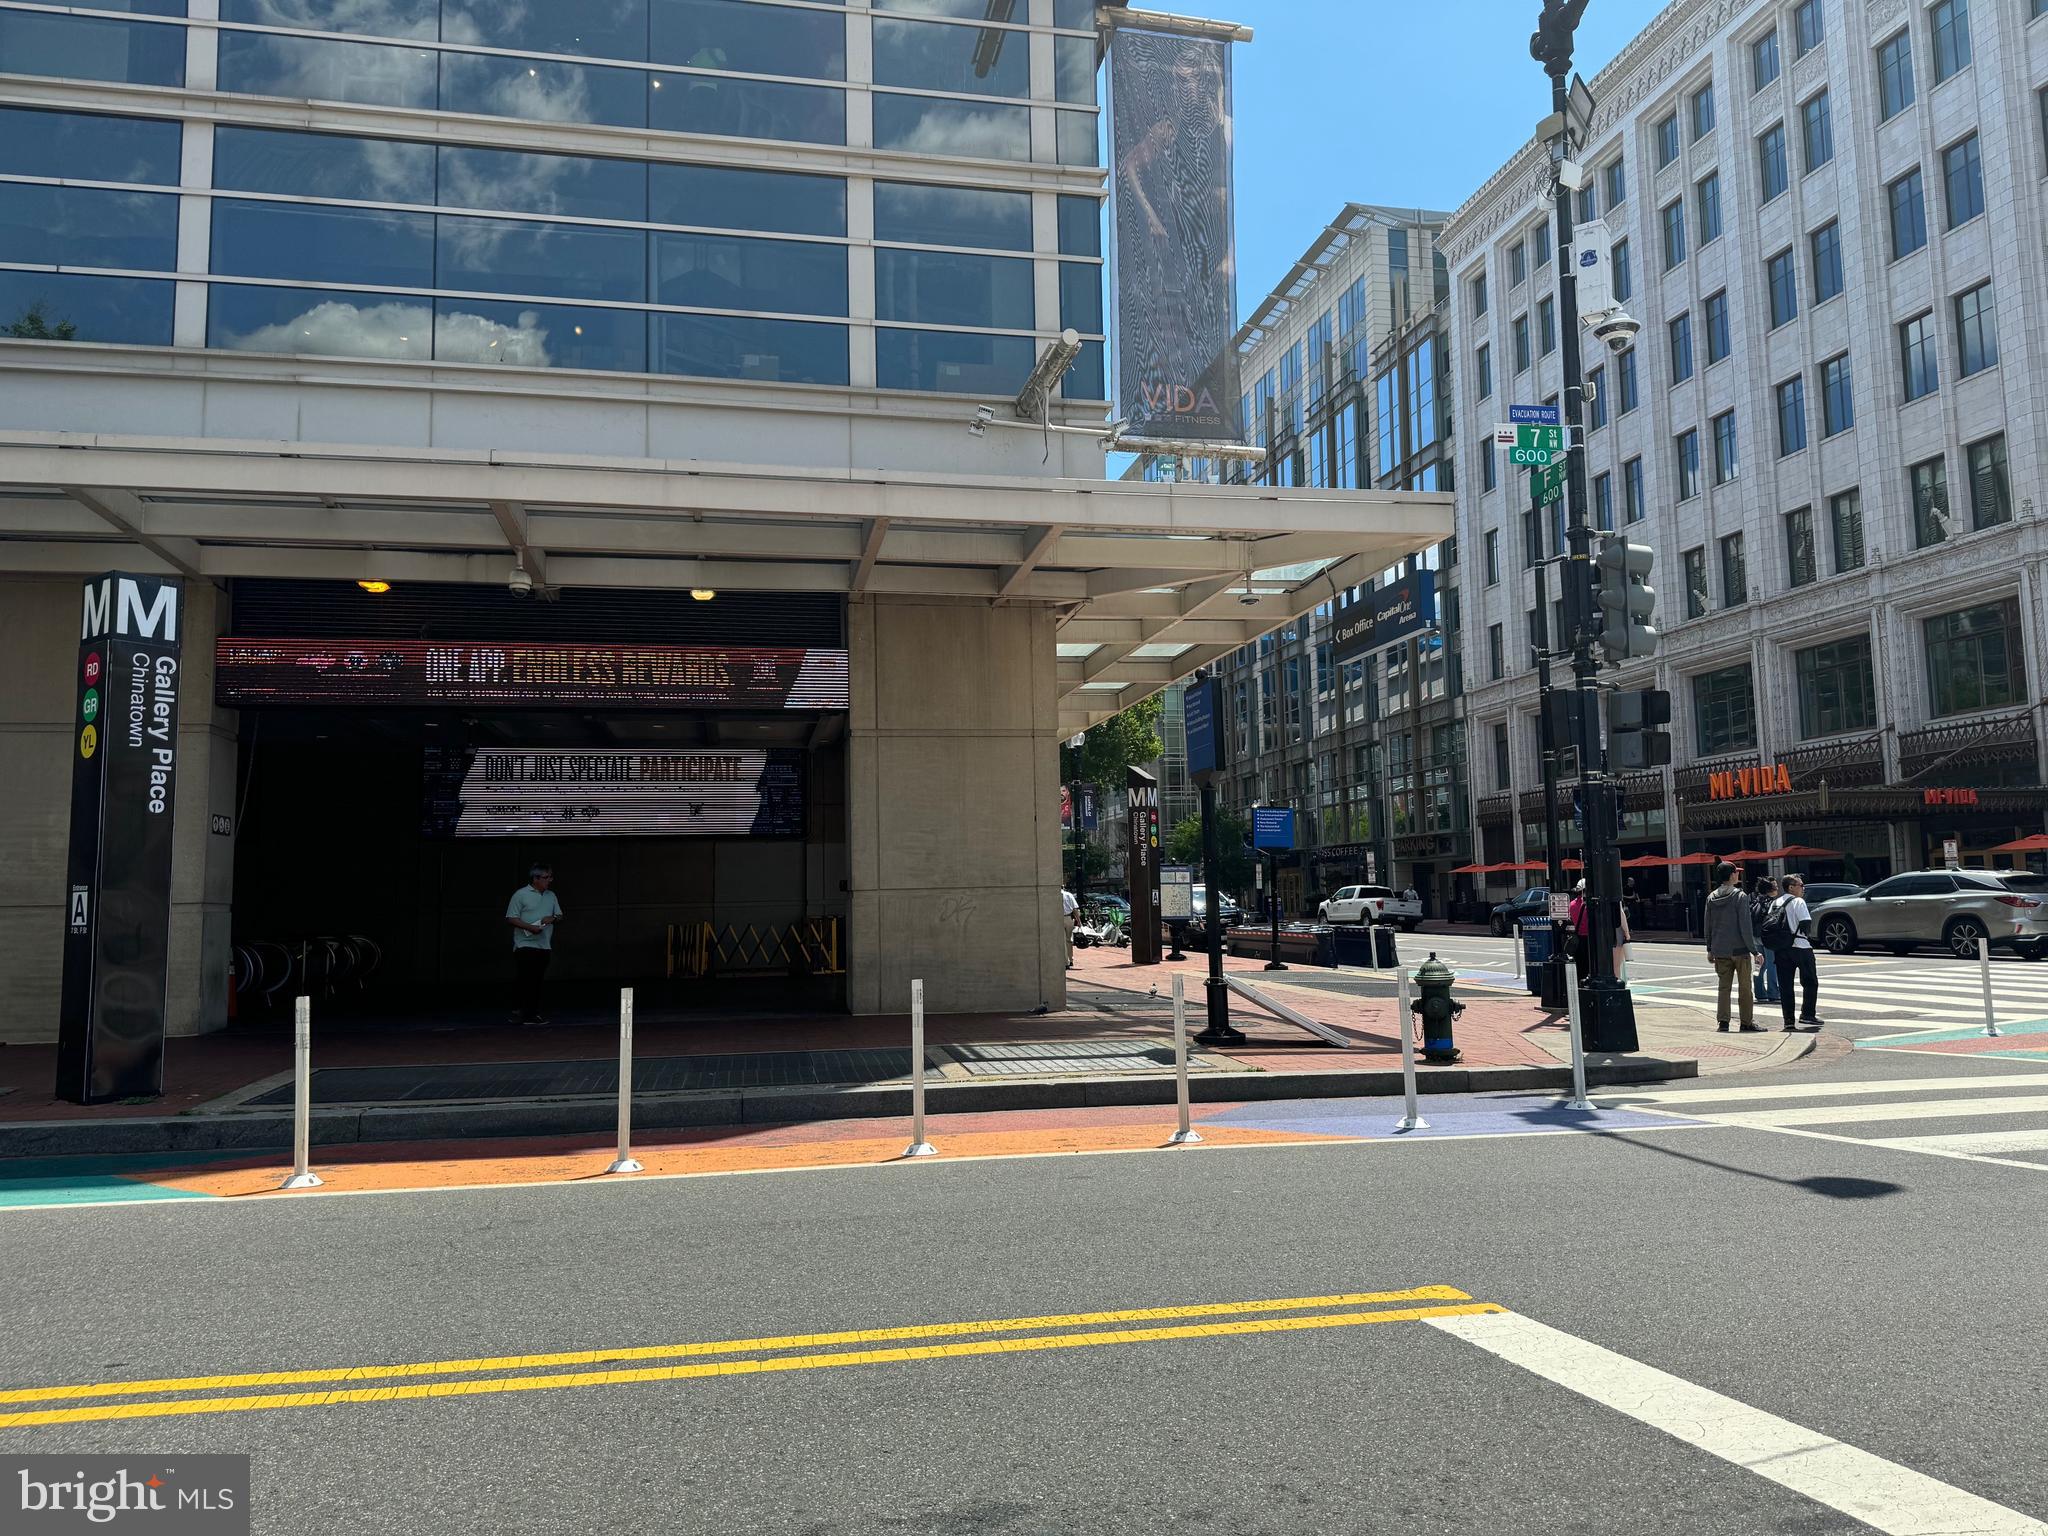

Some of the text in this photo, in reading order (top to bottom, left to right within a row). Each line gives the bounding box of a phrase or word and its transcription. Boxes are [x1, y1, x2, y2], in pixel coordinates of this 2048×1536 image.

[1141, 380, 1220, 414] VIDA
[1175, 415, 1221, 425] FITNESS
[1512, 409, 1556, 419] EVACUATION ROUTE
[1531, 429, 1557, 447] 7 St
[1549, 439, 1558, 448] NW
[1515, 449, 1547, 463] 600
[1543, 469, 1552, 489] F
[1543, 485, 1559, 503] 600
[82, 578, 112, 640] M
[117, 578, 177, 641] M
[1399, 612, 1417, 625] Arena
[1342, 617, 1374, 641] Box Office
[86, 662, 99, 677] RD
[426, 648, 736, 687] ONE APP. ENDLESS REWARDS.
[83, 697, 97, 714] GR
[129, 652, 151, 748] Chinatown
[83, 734, 94, 749] YL
[147, 656, 177, 814] Gallery Place
[485, 754, 527, 782] DON'T
[530, 755, 565, 782] JUST
[1128, 787, 1146, 807] M
[1147, 787, 1157, 807] M
[1332, 846, 1359, 857] COFFEE
[1395, 837, 1435, 850] PARKING
[73, 893, 86, 924] A
